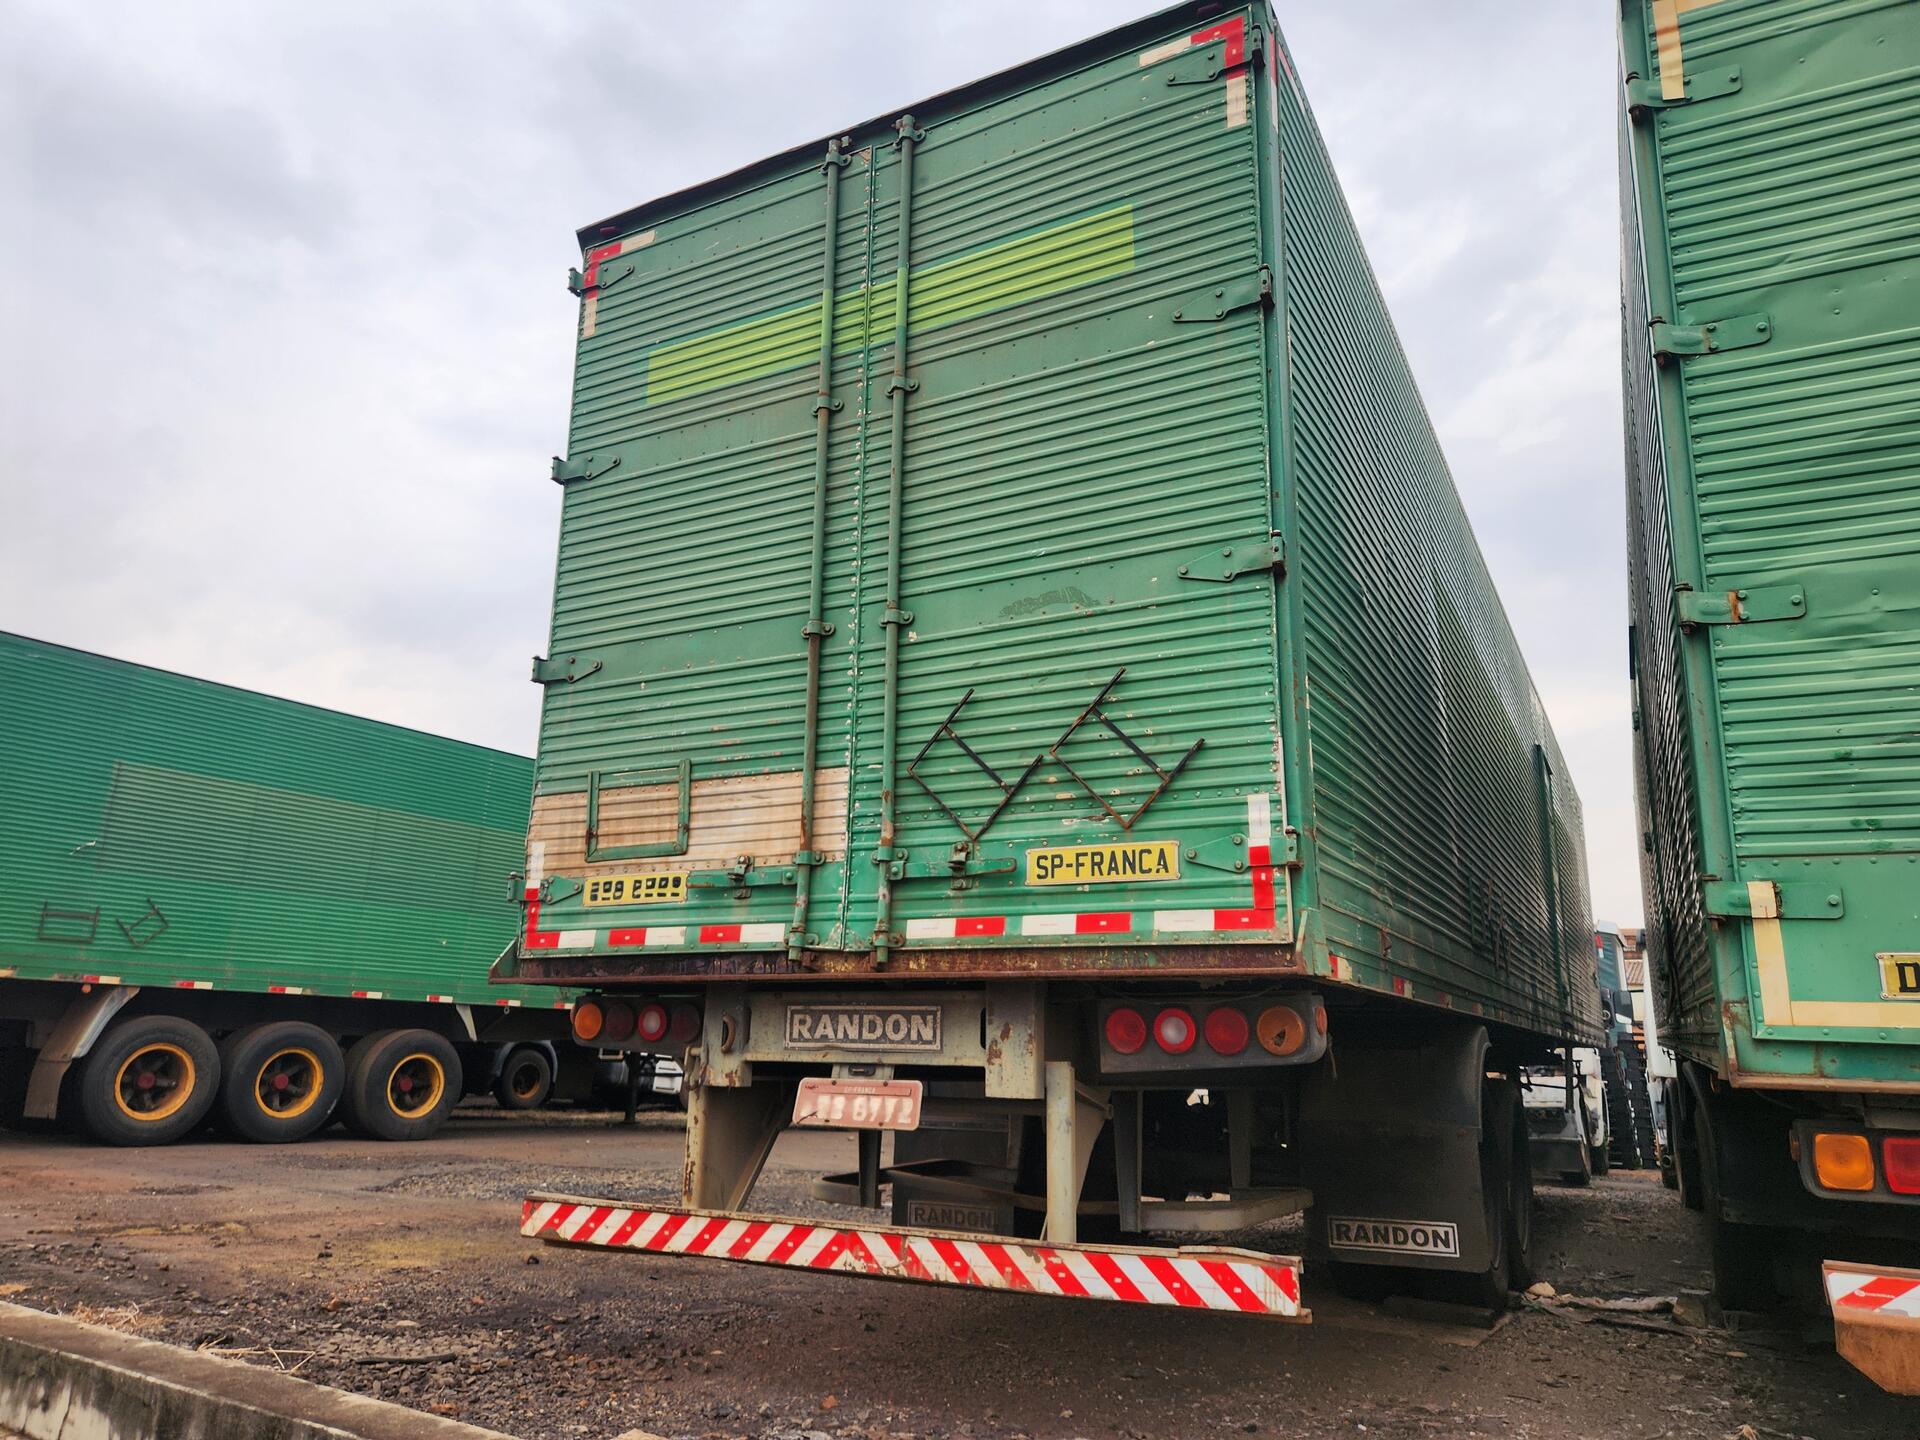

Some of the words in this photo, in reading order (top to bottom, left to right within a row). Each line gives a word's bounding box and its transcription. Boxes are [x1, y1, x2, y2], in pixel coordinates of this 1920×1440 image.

[1036, 848, 1170, 880] SP-FRANCA
[792, 1013, 934, 1042] RANDON
[914, 1206, 995, 1231] RANDON
[1334, 1223, 1451, 1249] RANDON
